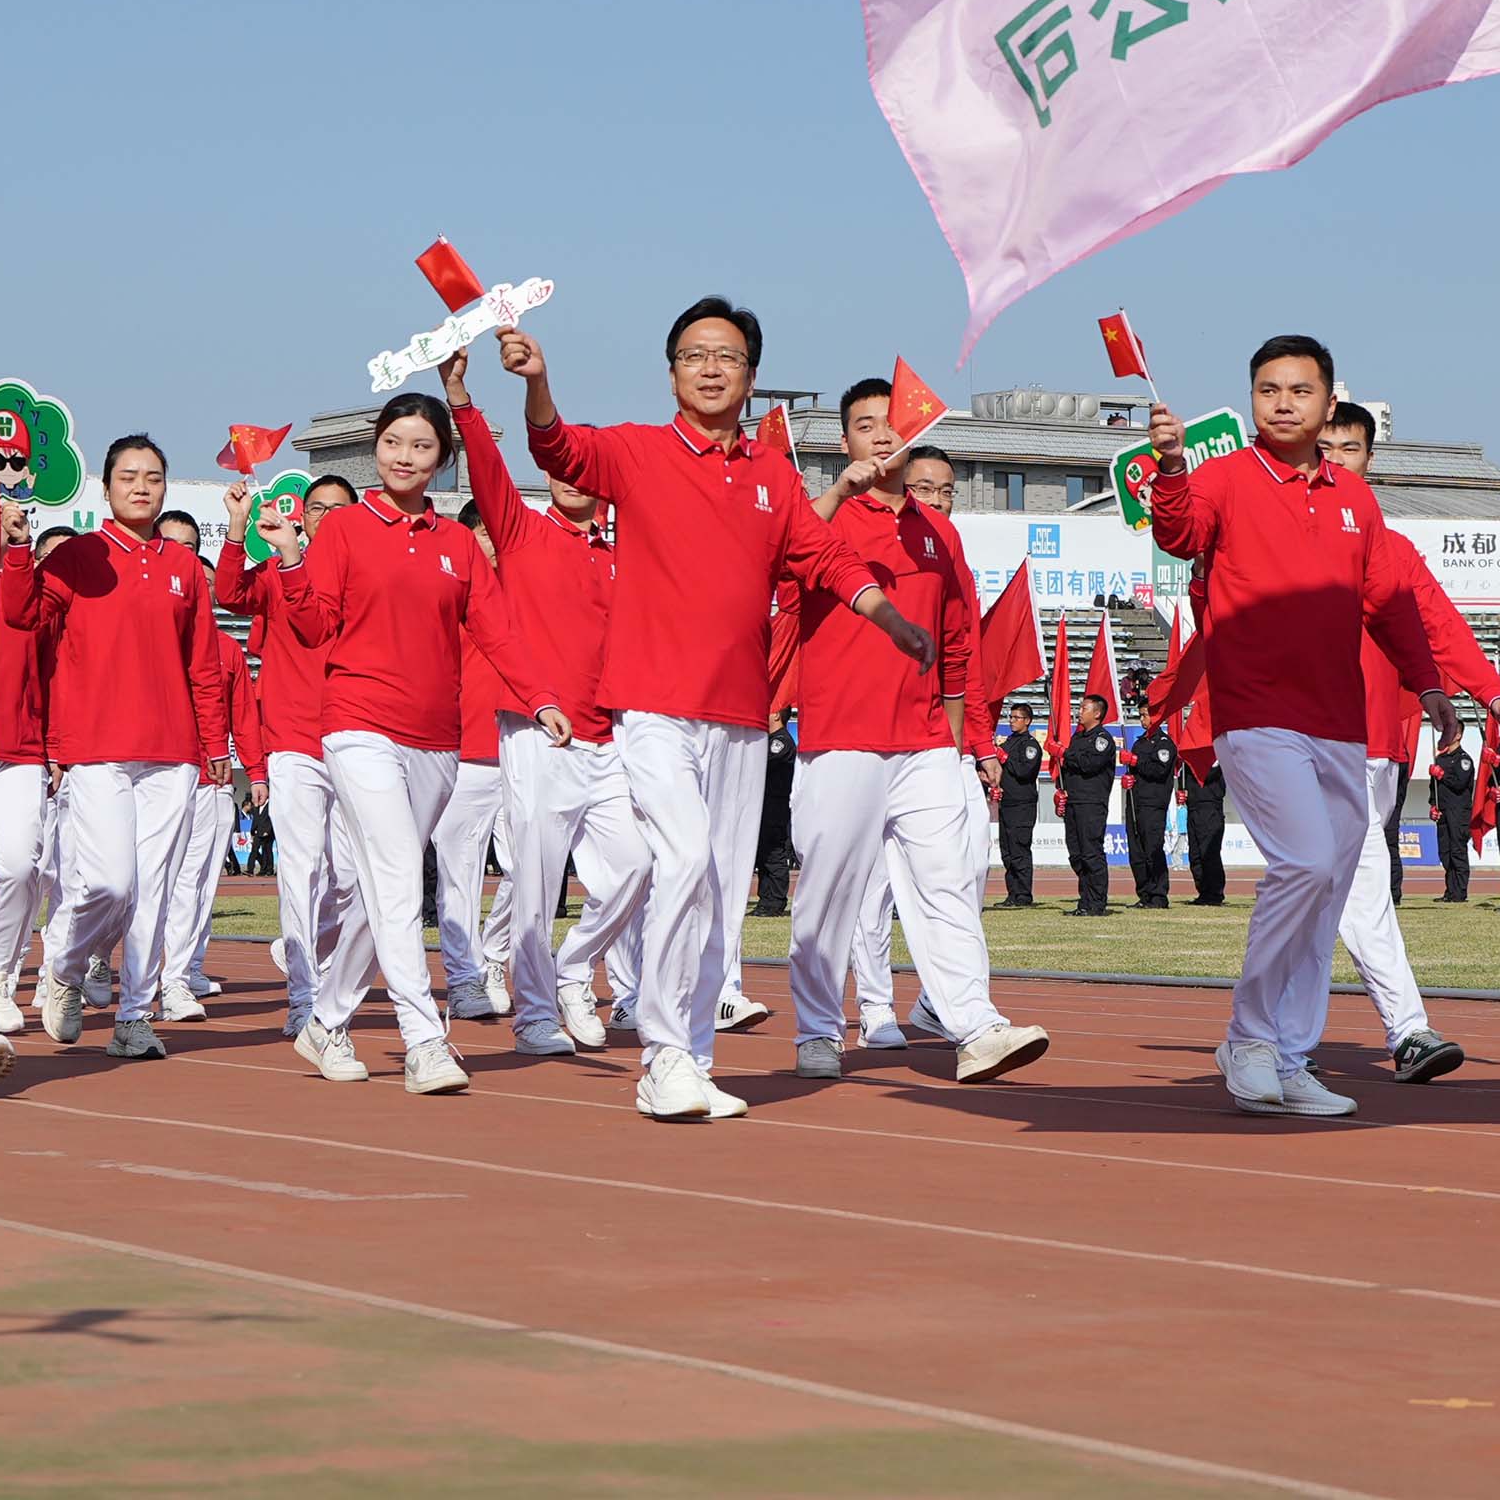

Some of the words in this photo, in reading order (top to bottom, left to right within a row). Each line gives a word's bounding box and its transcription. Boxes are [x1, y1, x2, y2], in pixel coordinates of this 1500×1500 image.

[1442, 558, 1475, 568] BANK
[1478, 558, 1494, 568] OF
[1136, 591, 1151, 605] 24
